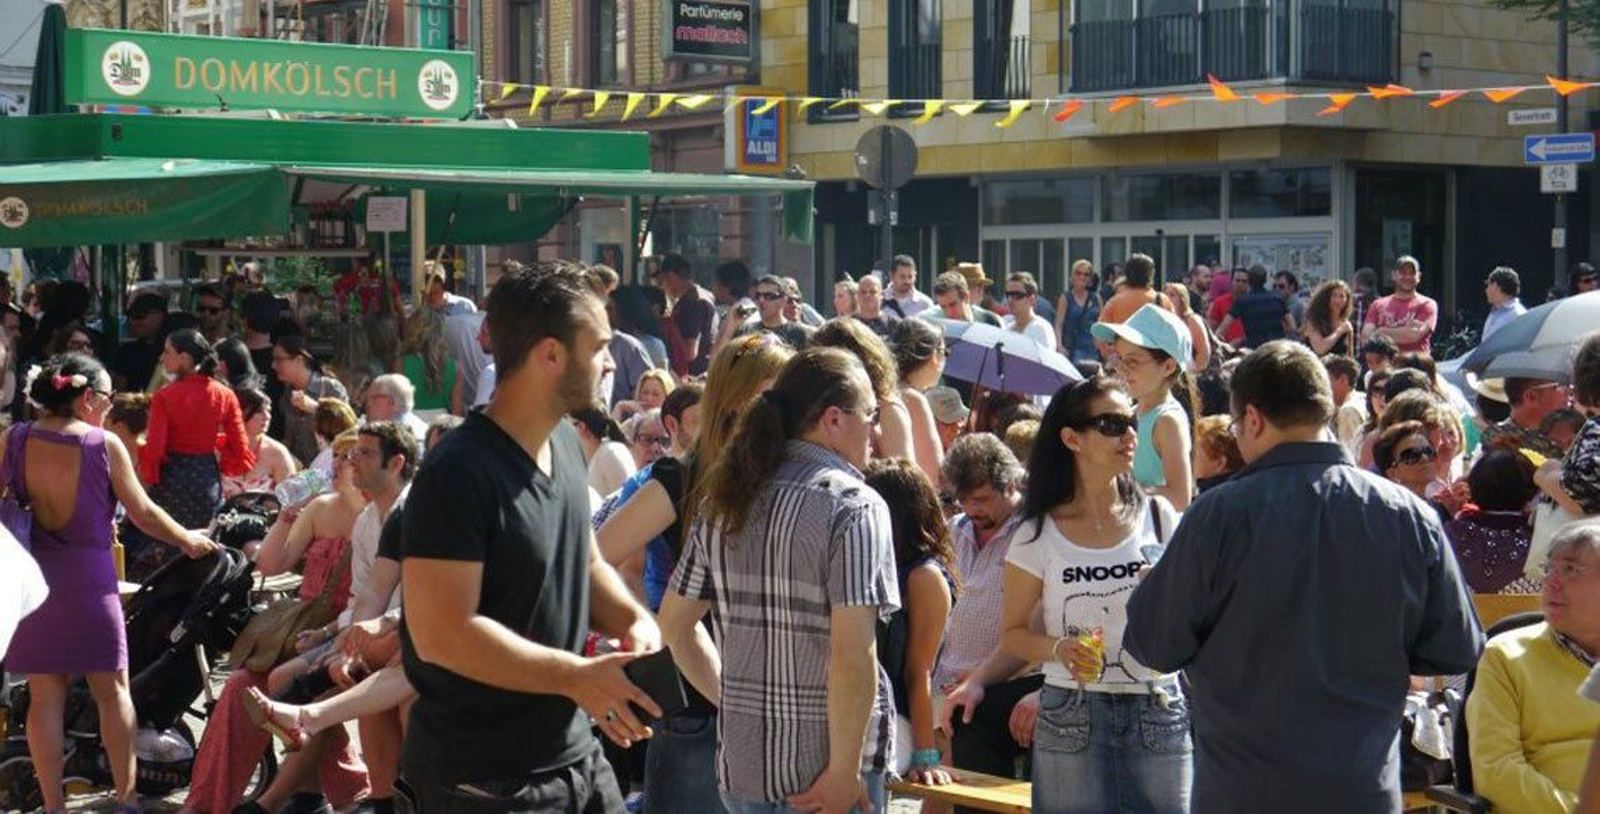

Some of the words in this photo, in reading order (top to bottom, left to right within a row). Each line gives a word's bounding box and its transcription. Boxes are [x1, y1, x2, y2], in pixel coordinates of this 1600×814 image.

[680, 3, 743, 22] Parfümerie
[174, 56, 398, 99] DOMKÖLSCH
[747, 140, 777, 155] ALDI
[1062, 560, 1147, 584] SNOOP
